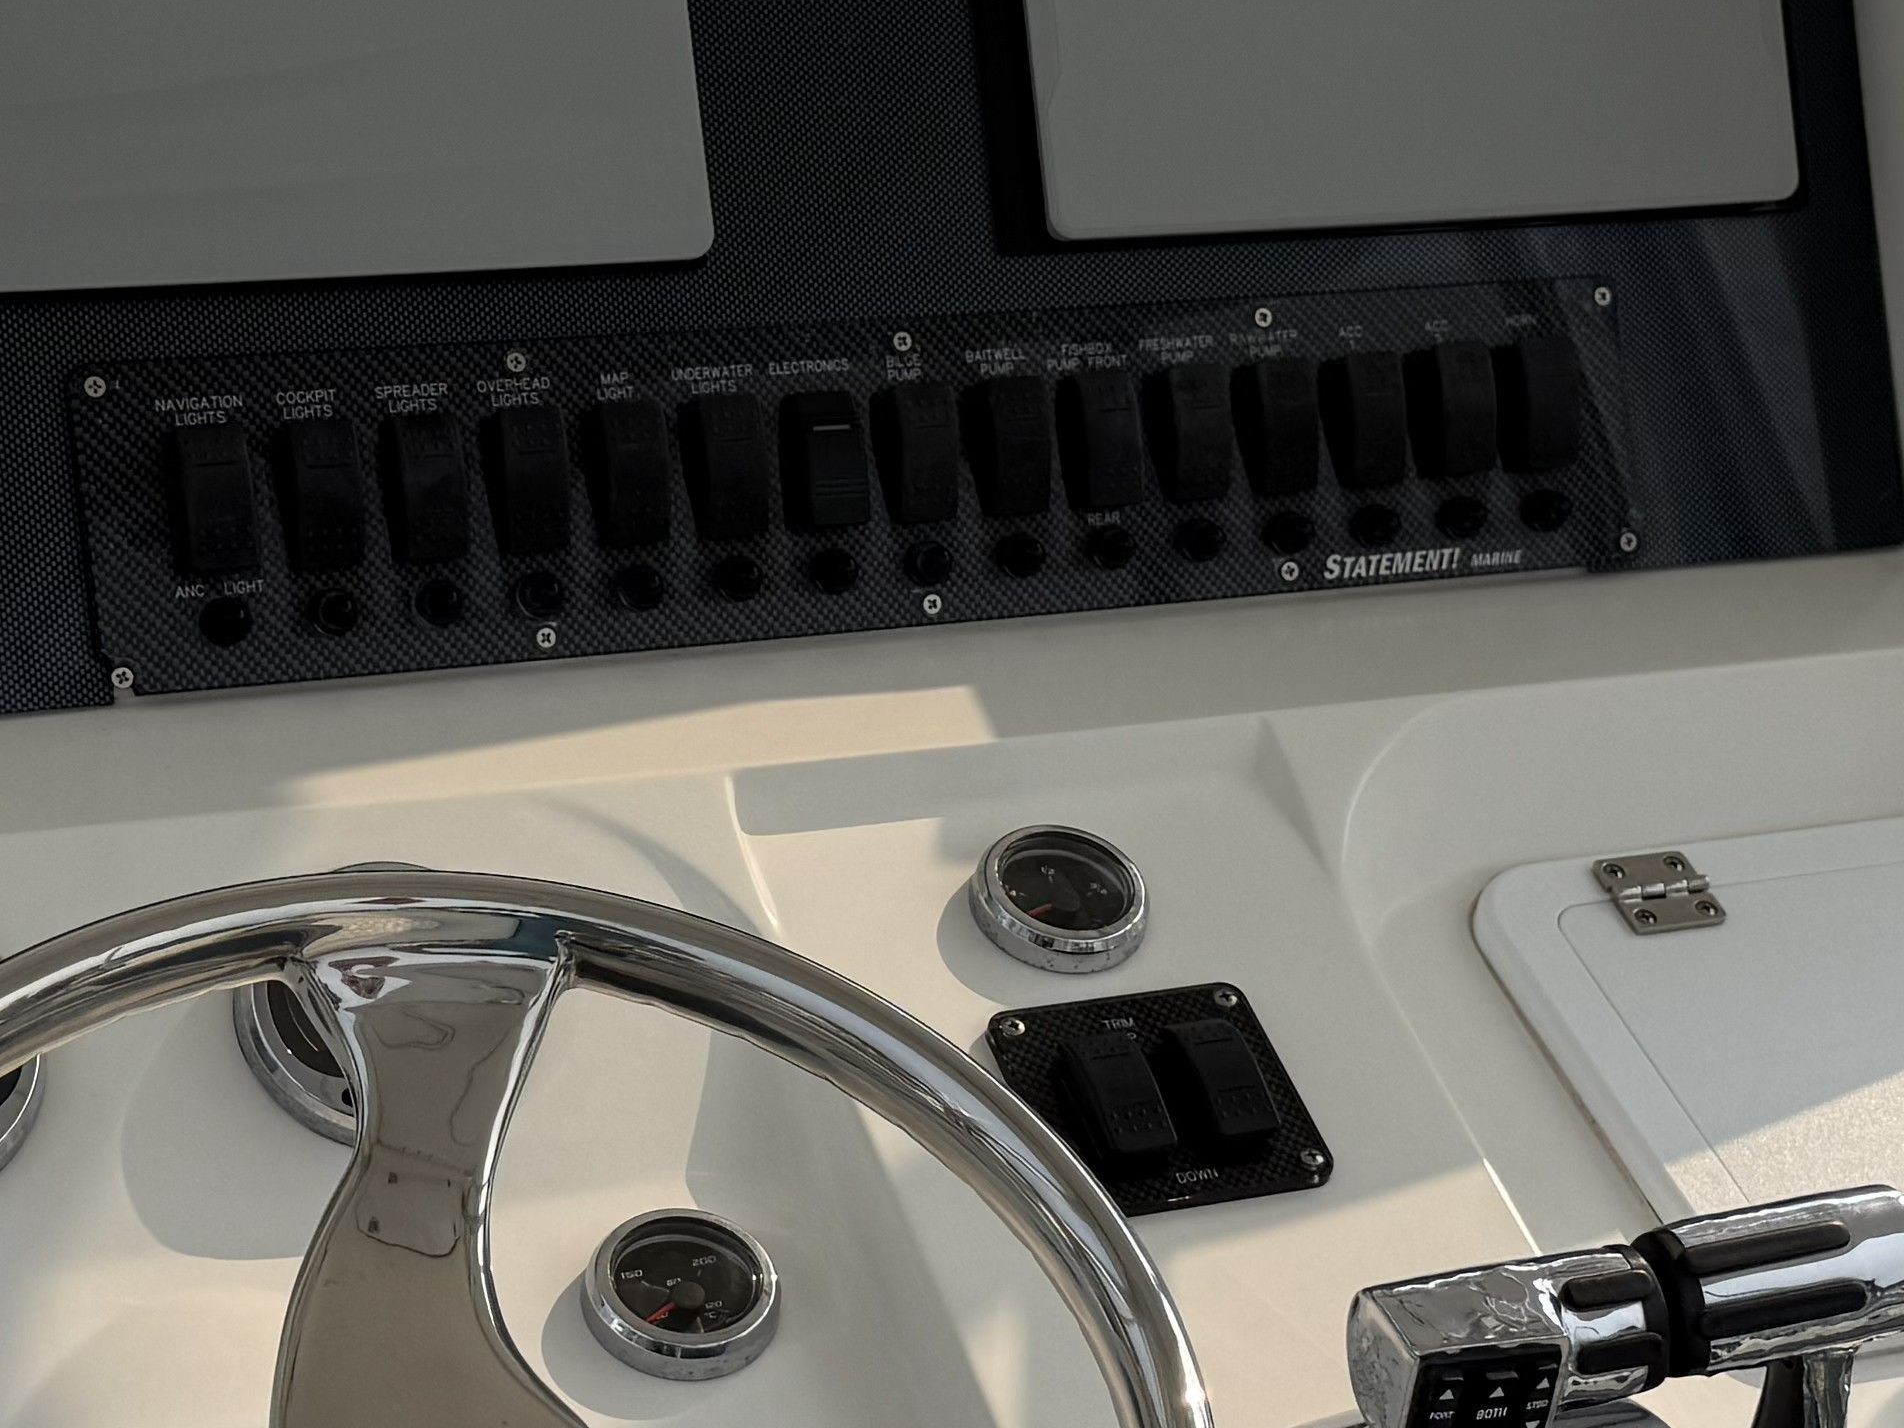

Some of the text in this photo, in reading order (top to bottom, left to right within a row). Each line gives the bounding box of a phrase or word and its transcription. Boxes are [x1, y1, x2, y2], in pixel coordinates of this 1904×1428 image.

[885, 353, 922, 369] BILGE
[964, 347, 1027, 364] BAITWELL
[1046, 354, 1127, 373] PUMP FRONT
[671, 363, 754, 381] UNDERWATER
[768, 357, 850, 376] ELECTRONICS
[979, 362, 1014, 376] PUMP
[599, 372, 629, 386] MAP
[887, 368, 922, 383] PUMP
[374, 382, 449, 400] SPREADER
[476, 376, 551, 393] OVERHEAD
[691, 380, 737, 395] LIGHTS
[275, 388, 337, 406] COCKPIT
[491, 392, 539, 408] LIGHTS
[596, 387, 634, 402] LIGHT
[156, 394, 244, 413] NAVIGATION
[388, 398, 438, 414] LIGHTS
[175, 410, 227, 427] LIGHTS
[283, 404, 334, 420] LIGHTS
[1087, 510, 1121, 526] REAR
[1322, 547, 1523, 580] STATEMENT! MARINE
[175, 578, 265, 599] ANC LIGHT
[1101, 1016, 1136, 1031] TRIM
[1176, 1168, 1219, 1185] DOWN
[692, 1255, 717, 1267] 200
[1475, 1406, 1508, 1421] BOTH
